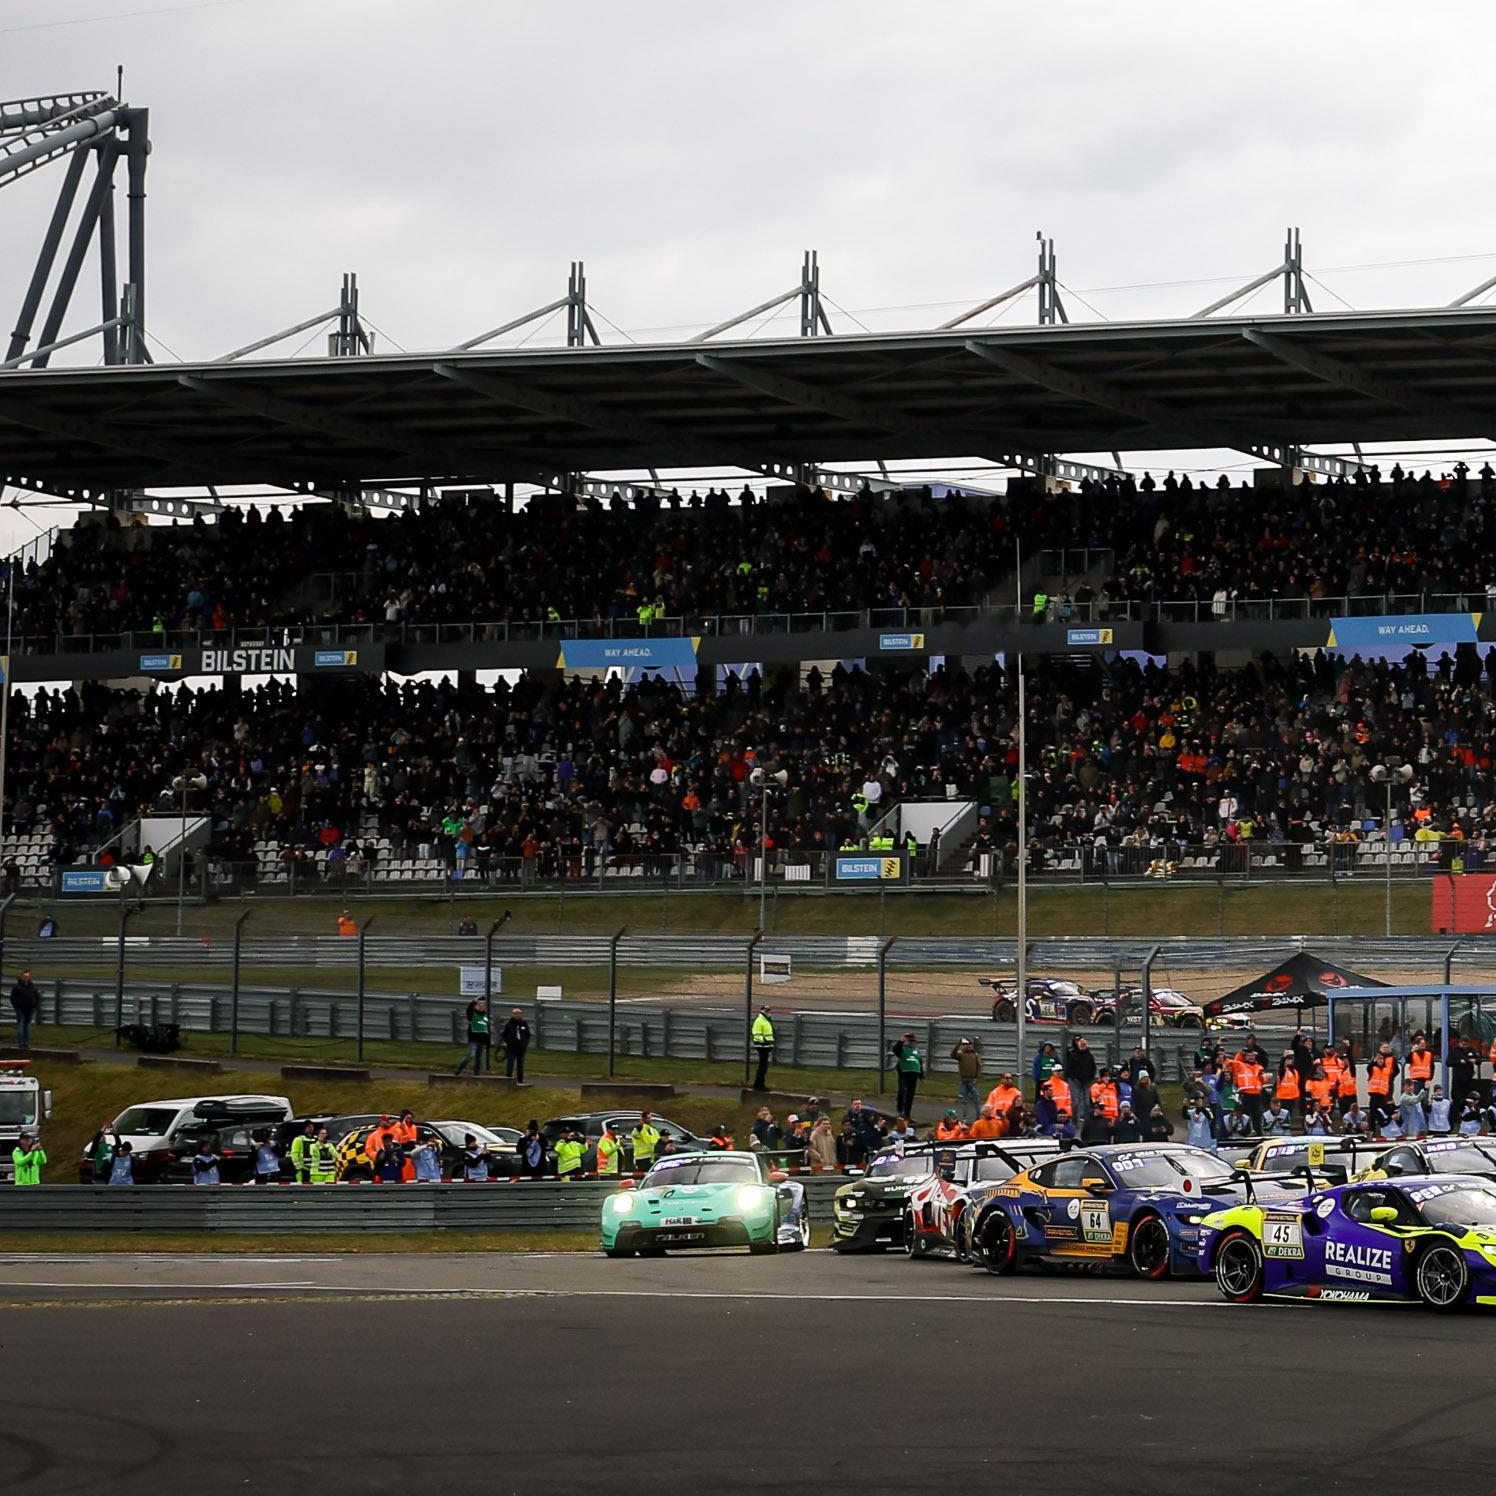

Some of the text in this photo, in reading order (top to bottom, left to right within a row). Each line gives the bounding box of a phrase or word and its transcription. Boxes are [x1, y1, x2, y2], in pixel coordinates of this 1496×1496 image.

[1378, 624, 1430, 635] WAY AHEAD.
[604, 647, 653, 658] WAY AHEAD.
[202, 648, 295, 672] BILSTEIN
[841, 864, 878, 873] BILSTEIN
[1089, 1212, 1102, 1229] 64
[1273, 1225, 1290, 1244] 45
[1278, 1247, 1302, 1257] DEKRA
[1325, 1240, 1392, 1270] REALIZE
[1335, 1268, 1382, 1281] GROUP
[1319, 1289, 1370, 1301] YOKOHAMA
